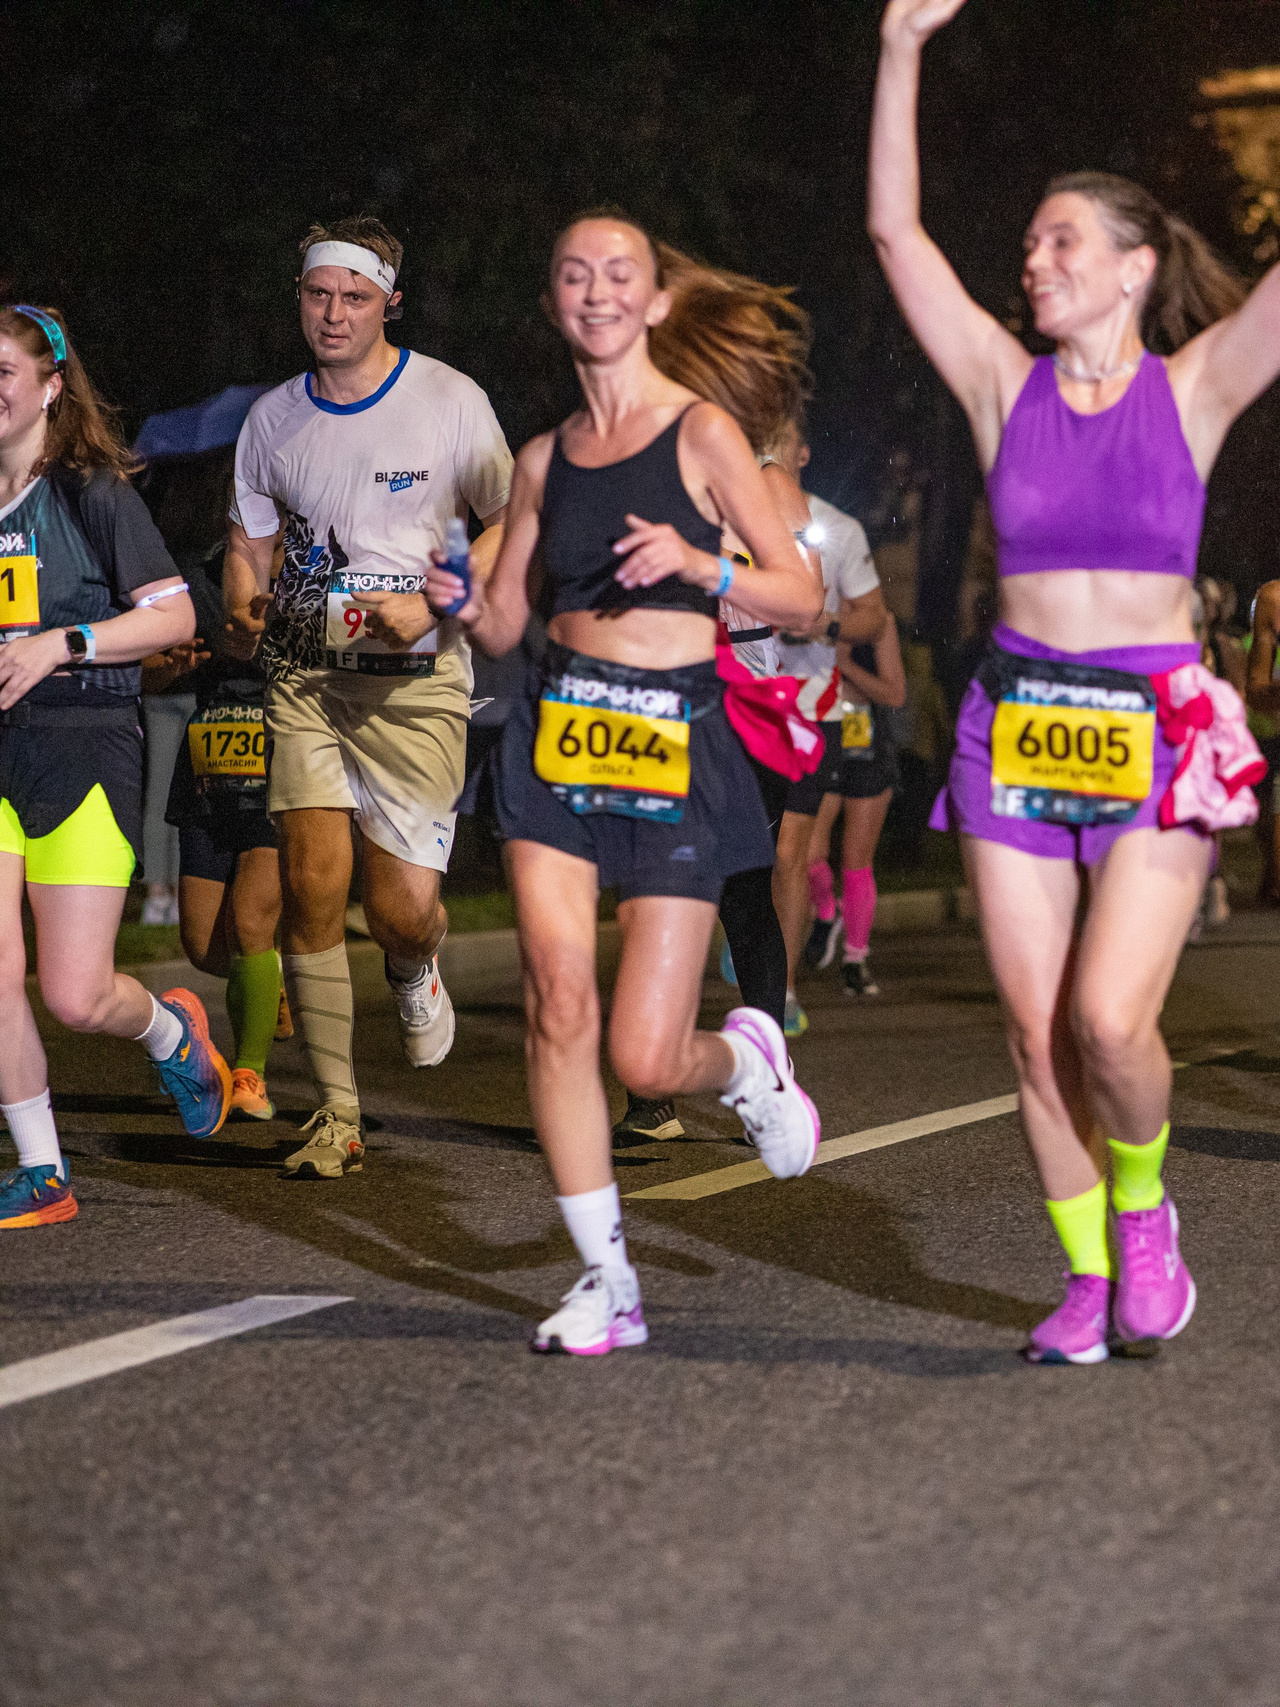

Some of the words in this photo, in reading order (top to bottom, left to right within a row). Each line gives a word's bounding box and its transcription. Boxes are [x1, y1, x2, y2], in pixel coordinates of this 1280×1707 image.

[375, 470, 429, 483] BI.ZONE
[391, 479, 411, 490] RUN
[1, 567, 15, 602] 1
[201, 731, 264, 757] 1730
[558, 719, 669, 764] 6044
[1018, 720, 1130, 767] 6005
[207, 760, 257, 768] АНАСТАСИЯ
